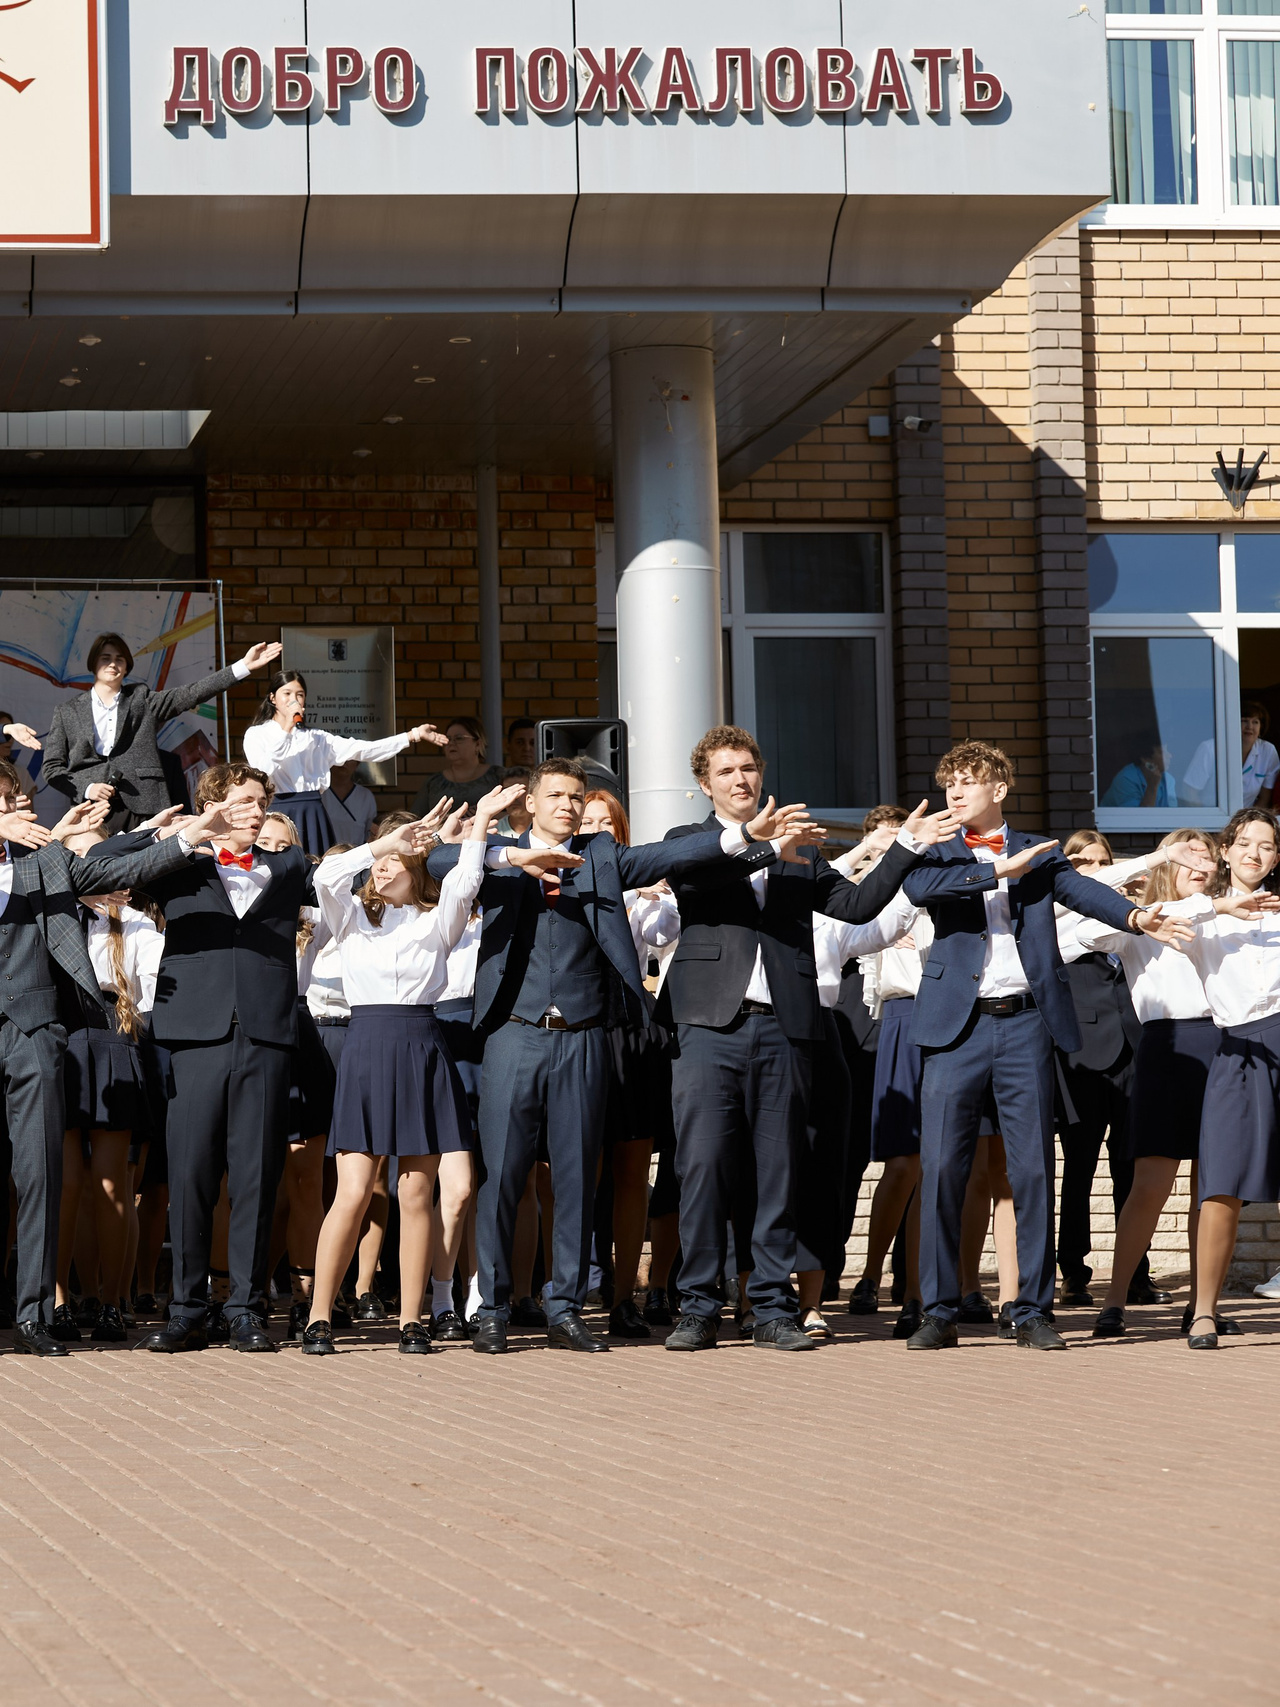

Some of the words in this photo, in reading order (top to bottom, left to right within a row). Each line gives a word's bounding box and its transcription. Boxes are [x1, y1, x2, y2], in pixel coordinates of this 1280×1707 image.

[163, 45, 418, 124] ДОБРО
[474, 46, 1005, 114] ПОЖАЛОВАТЬ
[322, 715, 340, 724] нче
